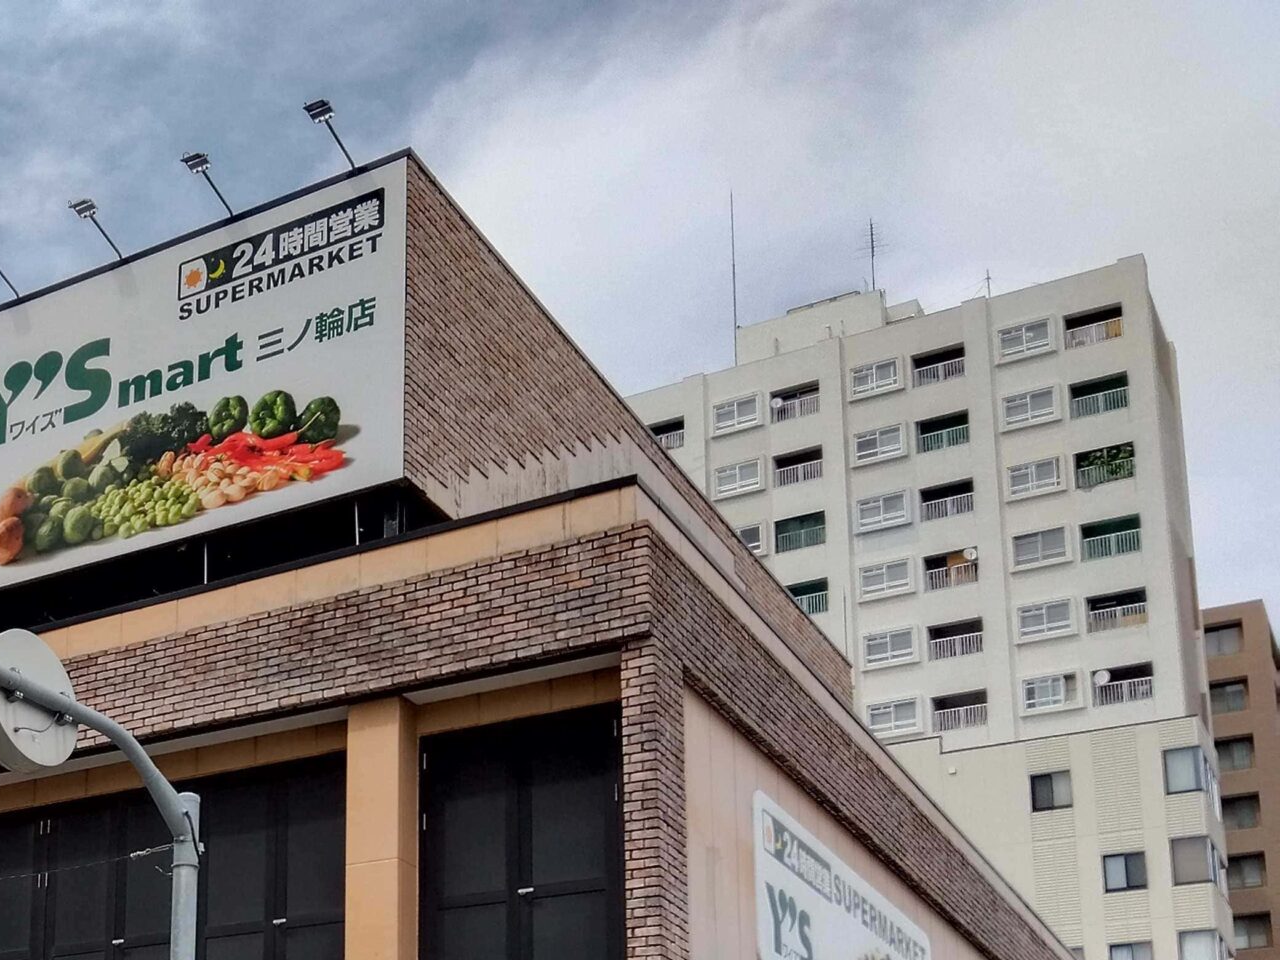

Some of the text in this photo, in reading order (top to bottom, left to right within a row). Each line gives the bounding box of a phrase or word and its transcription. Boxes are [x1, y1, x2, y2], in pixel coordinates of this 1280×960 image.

[178, 232, 383, 321] SUPERMARKET
[231, 198, 382, 280] 24時間営業
[117, 332, 243, 408] mart
[256, 296, 377, 363] 三ノ輪店
